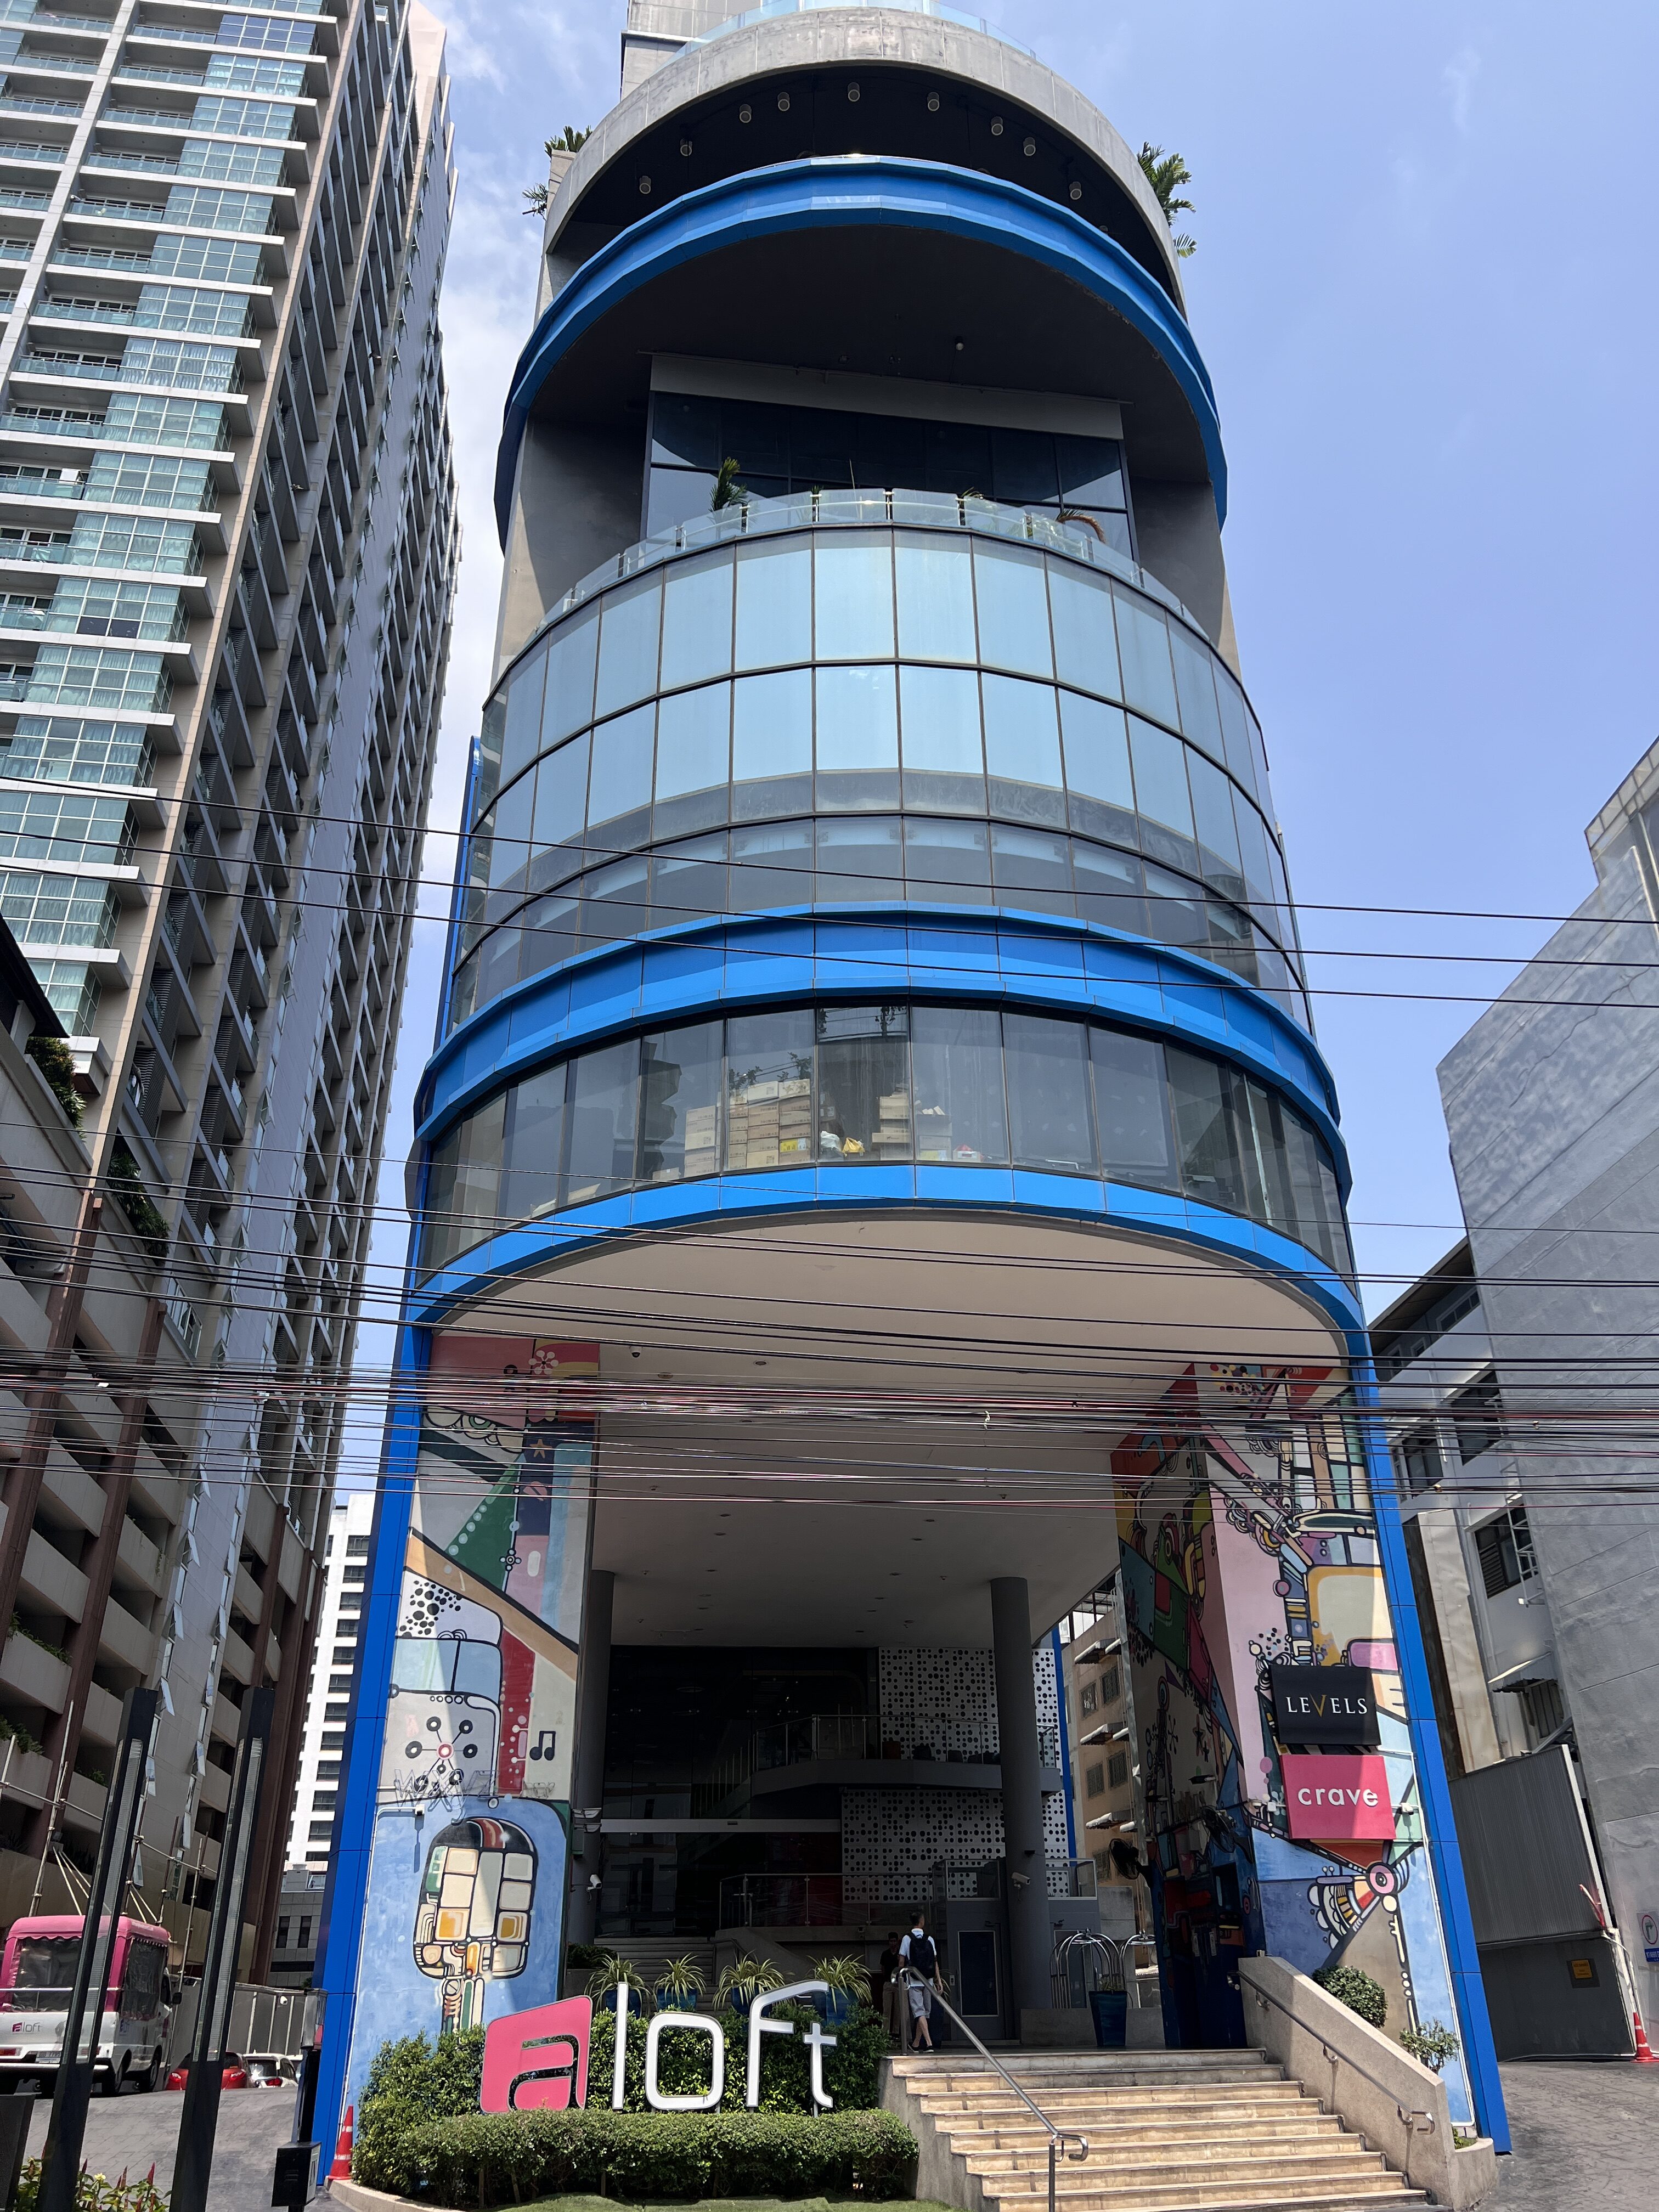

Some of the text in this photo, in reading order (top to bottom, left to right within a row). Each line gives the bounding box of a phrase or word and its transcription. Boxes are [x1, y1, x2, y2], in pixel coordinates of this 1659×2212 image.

[1286, 1693, 1368, 1717] LEVELS
[1298, 1787, 1378, 1807] crave
[12, 2022, 43, 2033] aloft
[481, 1979, 838, 2113] aloft
